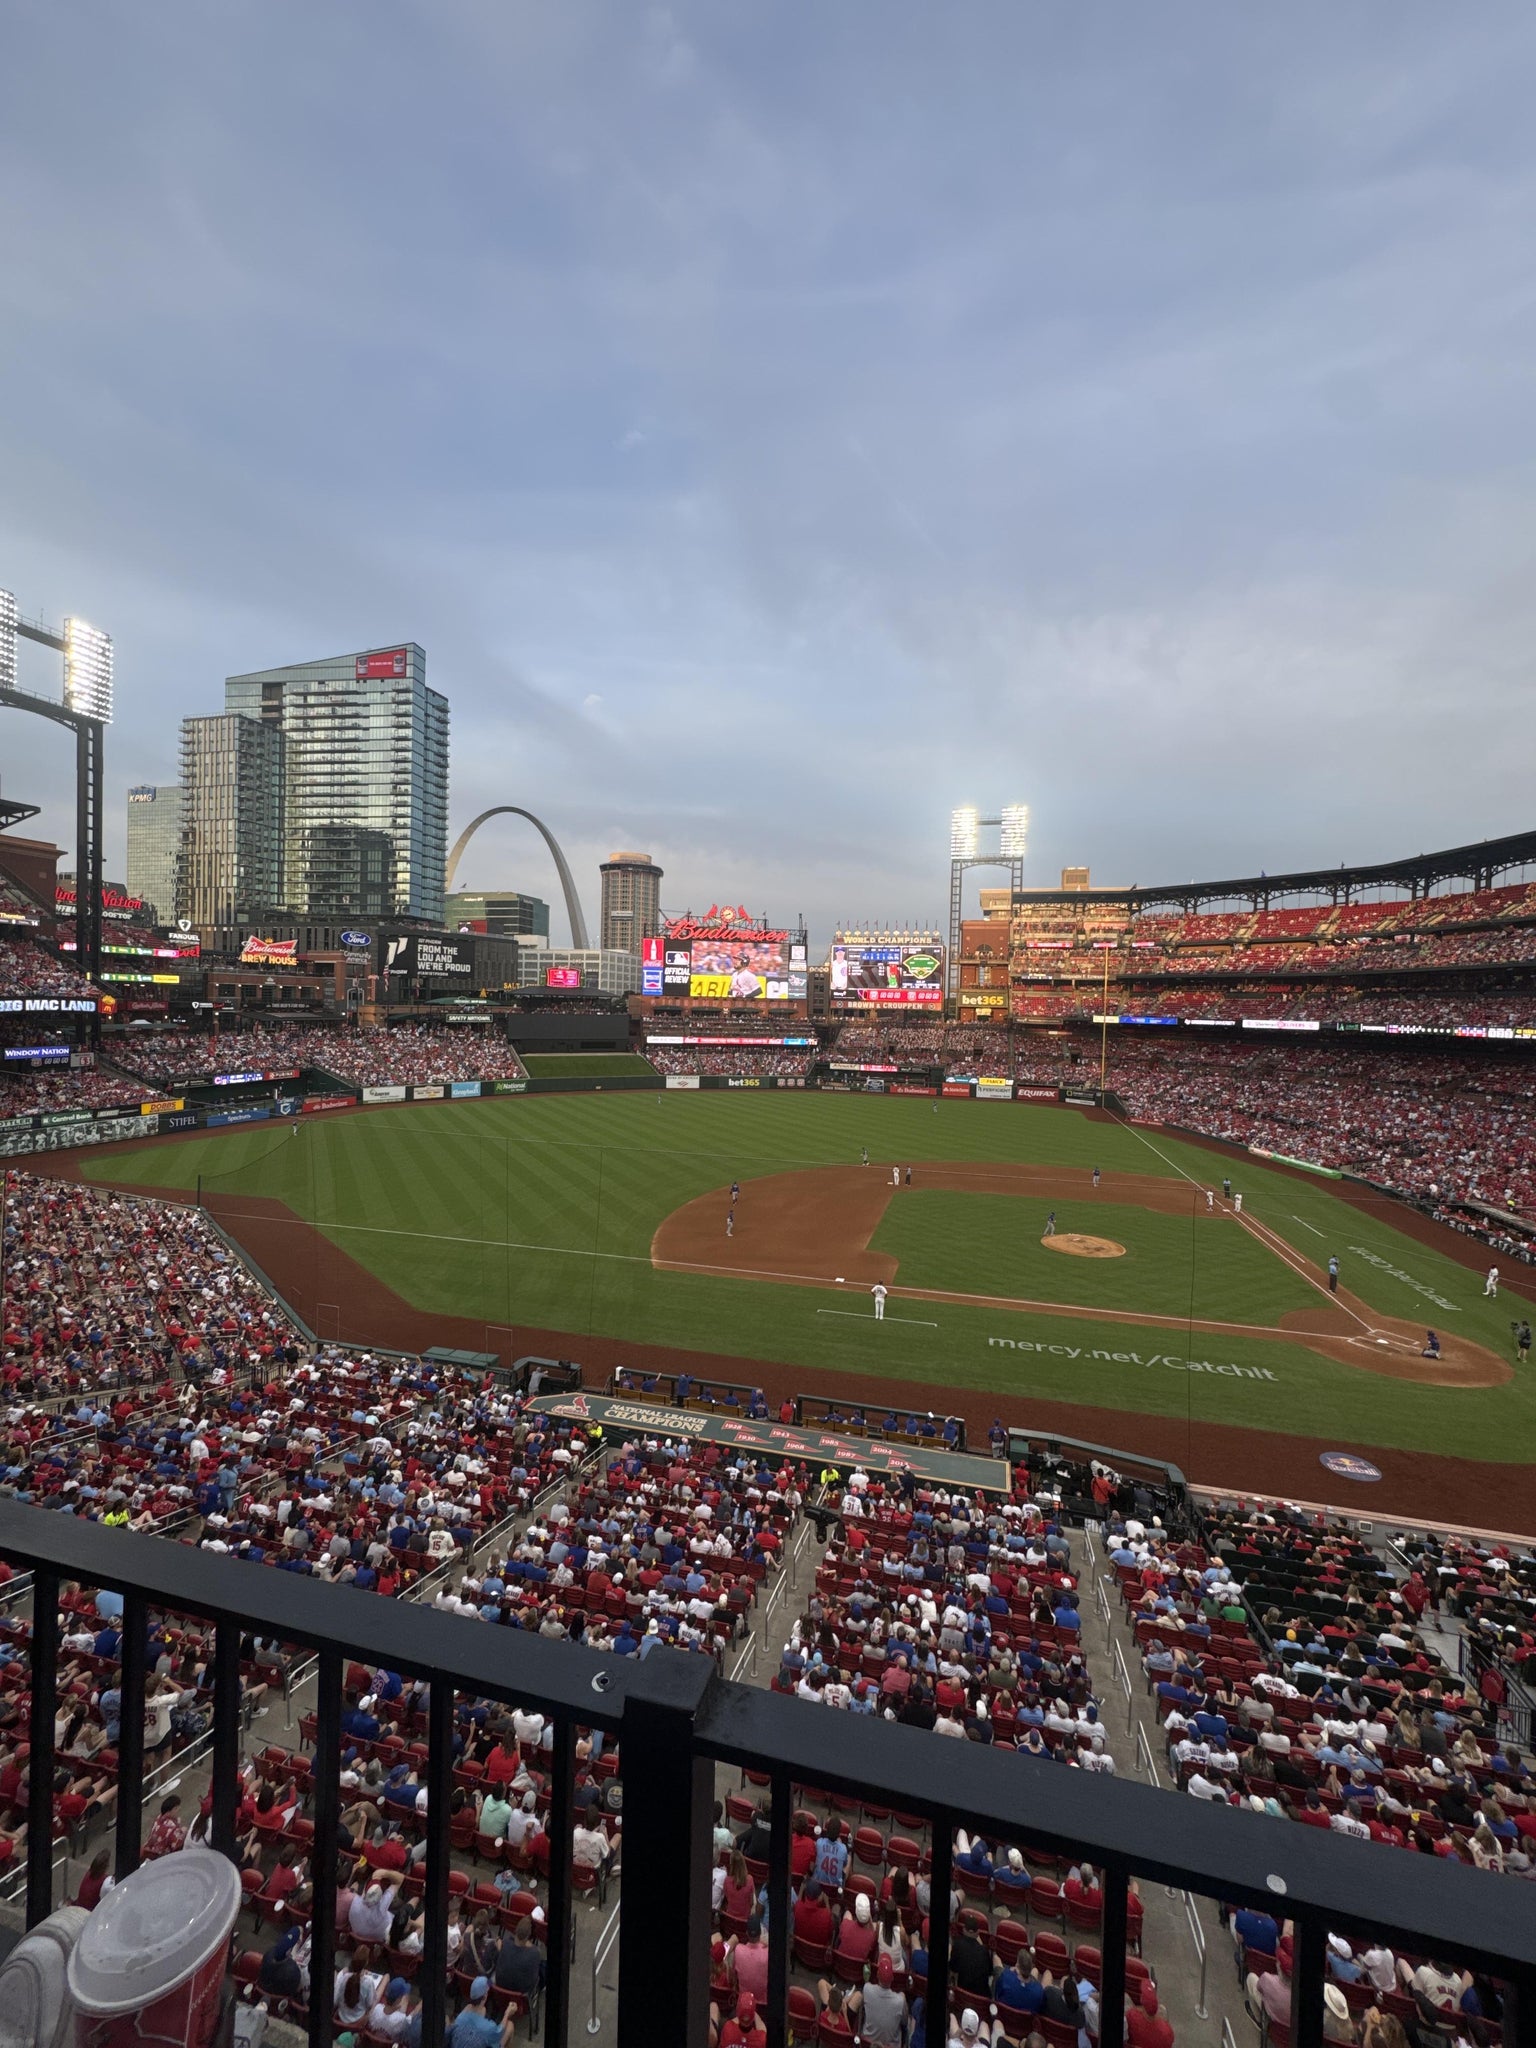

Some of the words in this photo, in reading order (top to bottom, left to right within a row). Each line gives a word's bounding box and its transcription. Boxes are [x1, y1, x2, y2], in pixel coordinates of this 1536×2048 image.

[129, 794, 152, 802] KPMG
[102, 889, 142, 909] Nation
[666, 919, 788, 941] Budweiser
[168, 932, 200, 941] FANDUEL
[348, 933, 366, 943] Ford
[241, 940, 296, 954] Budweiser
[417, 944, 441, 954] FROM
[443, 946, 458, 955] THE
[241, 954, 267, 963] BREW
[269, 956, 297, 965] HOUSE
[417, 953, 433, 961] LOU
[435, 954, 453, 963] AND
[417, 961, 443, 970] WE'RE
[445, 963, 471, 972] PROUD
[665, 967, 690, 975] OFFICIAL
[962, 995, 1004, 1005] bet365
[25, 1000, 60, 1011] MAC
[61, 1000, 96, 1011] LAND
[5, 1049, 40, 1057] WINDOW
[41, 1048, 69, 1056] NATION
[503, 1082, 526, 1090] National
[728, 1078, 760, 1087] bet365
[1017, 1088, 1057, 1098] EQUIFAX
[151, 1101, 176, 1110] DOBBS
[52, 1114, 75, 1123] Central
[169, 1115, 198, 1128] STIFEL
[988, 1336, 1280, 1382] mercy.net/CatchIt
[610, 1403, 661, 1418] NATIONAL
[662, 1412, 709, 1425] LEAGUE
[603, 1409, 704, 1433] CHAMPIONS
[837, 1450, 856, 1458] 1987
[872, 1446, 893, 1455] 2004
[432, 1541, 441, 1551] 15
[821, 1855, 839, 1878] 46
